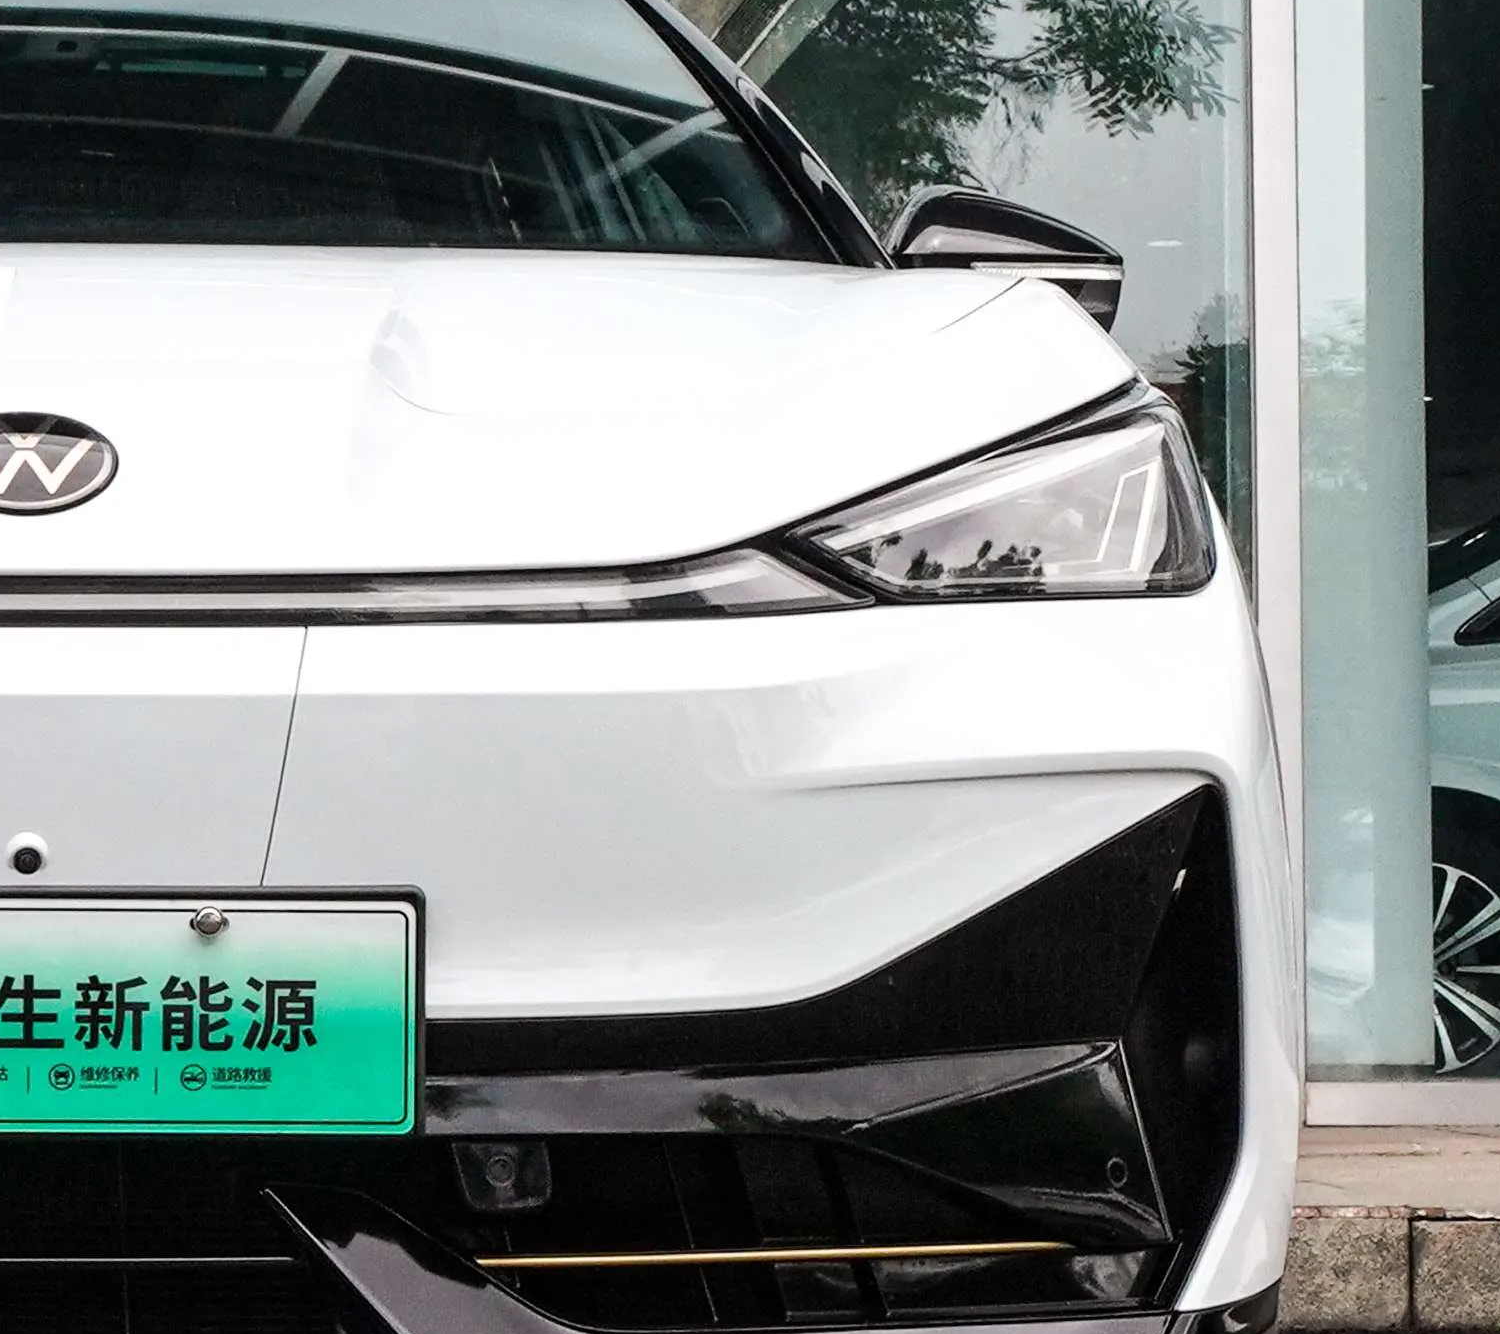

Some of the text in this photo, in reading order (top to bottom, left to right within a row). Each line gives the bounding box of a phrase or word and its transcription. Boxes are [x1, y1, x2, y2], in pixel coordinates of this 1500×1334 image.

[80, 1066, 140, 1083] 维修保养
[211, 1066, 273, 1083] 道路救援
